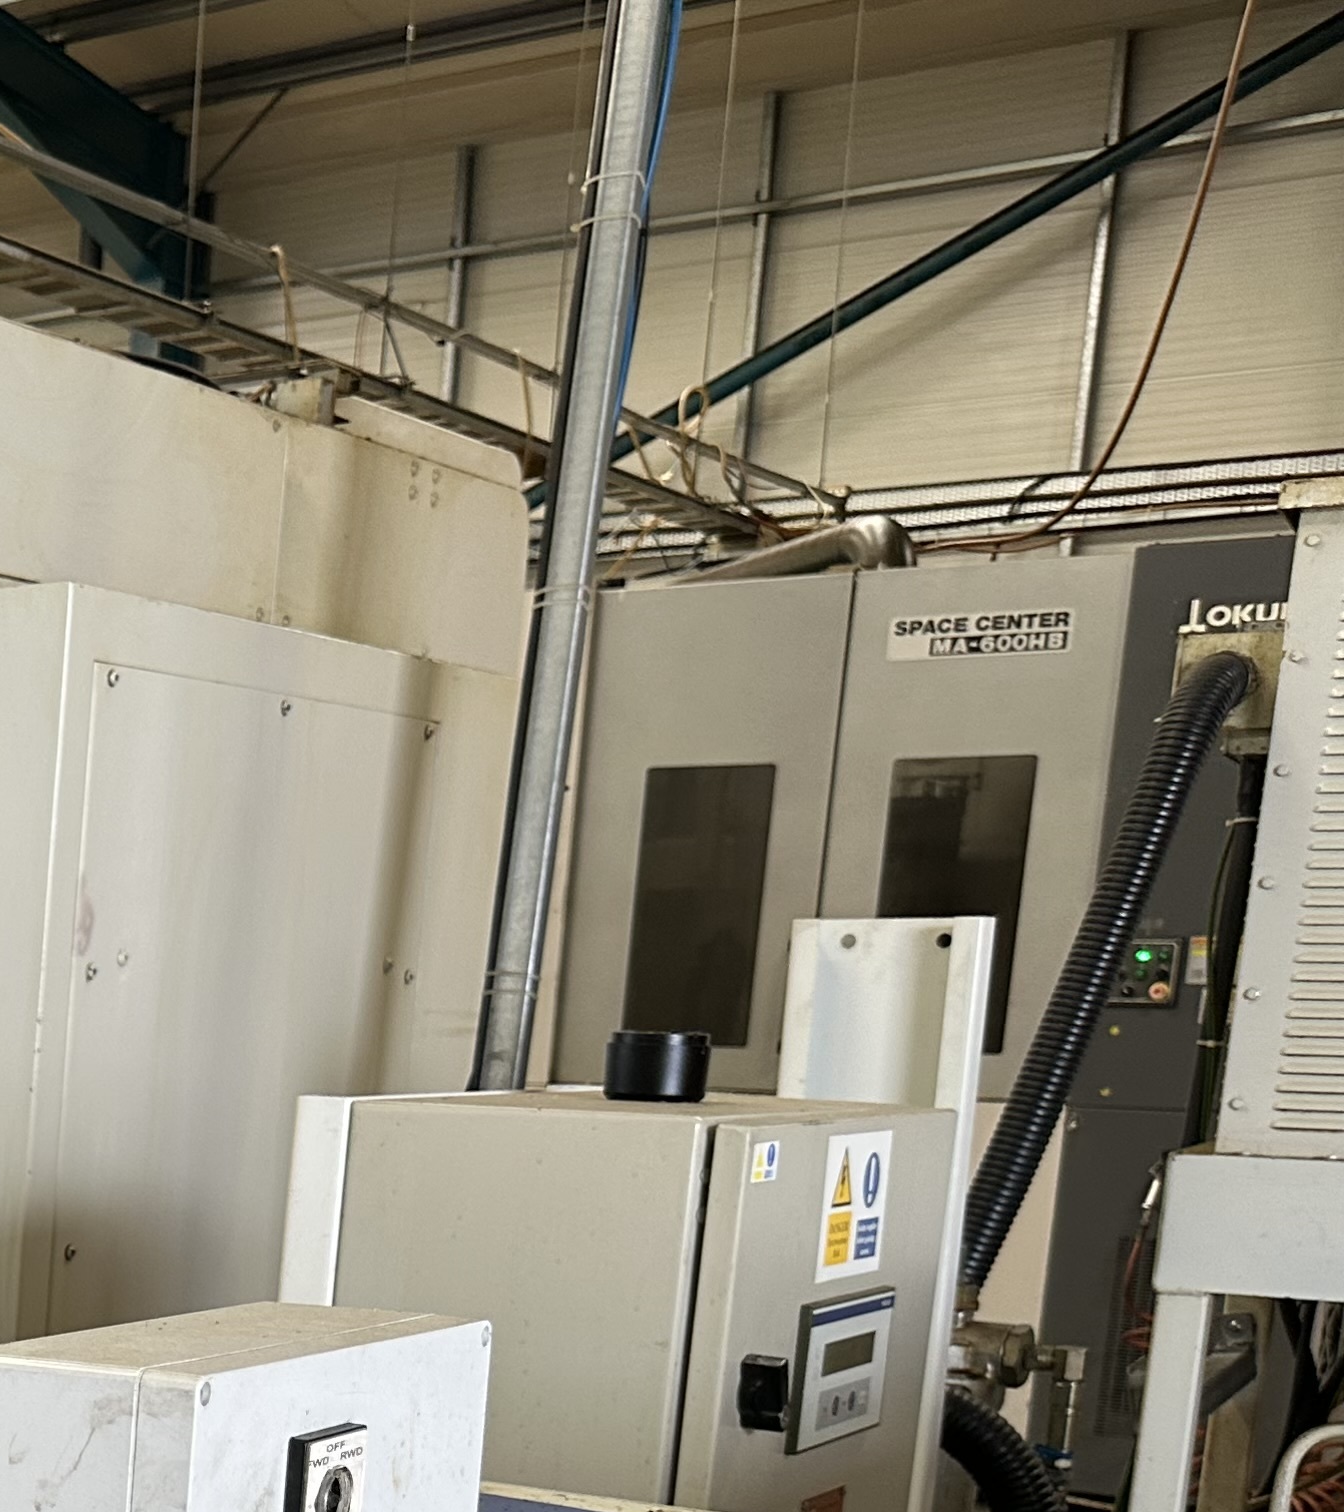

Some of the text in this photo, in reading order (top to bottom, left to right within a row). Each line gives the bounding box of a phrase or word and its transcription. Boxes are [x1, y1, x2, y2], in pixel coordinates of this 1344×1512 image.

[894, 611, 1071, 637] SPACE CENTER
[931, 632, 1065, 656] MA-600HB
[326, 1440, 346, 1453] OFF
[340, 1446, 363, 1460] RWD
